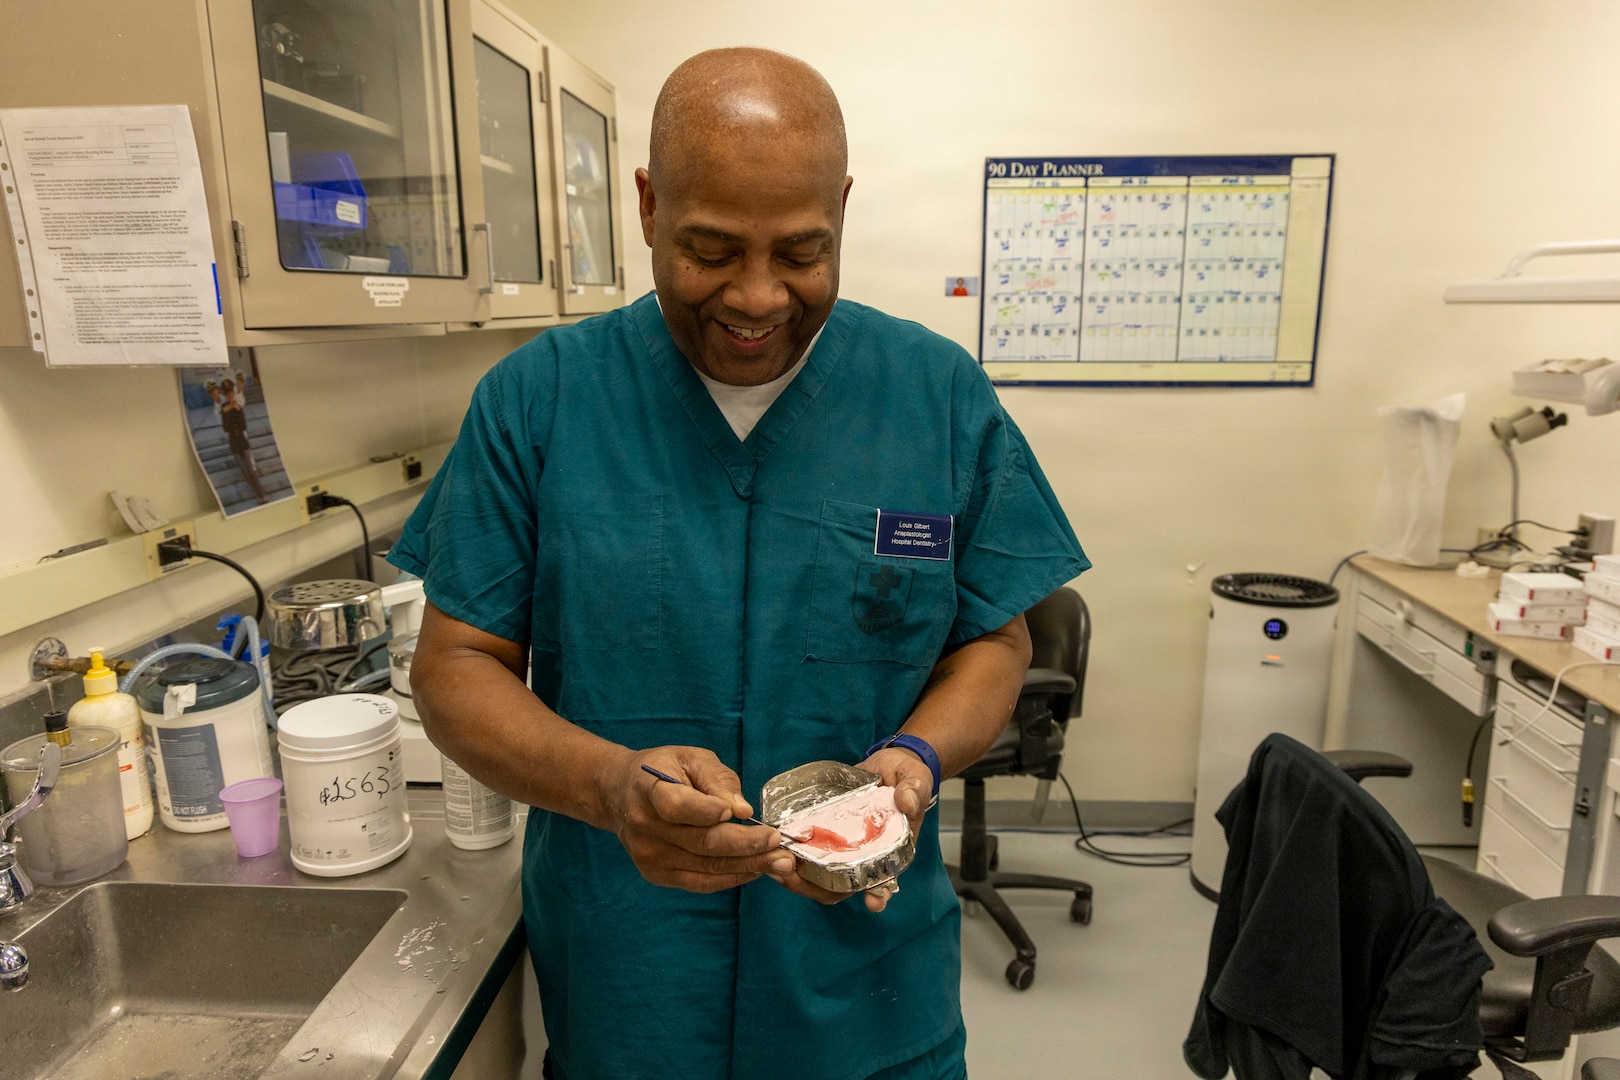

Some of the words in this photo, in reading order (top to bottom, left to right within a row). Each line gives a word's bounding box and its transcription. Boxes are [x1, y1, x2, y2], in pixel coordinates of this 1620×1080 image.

[988, 162, 1007, 177] 90
[1010, 162, 1040, 177] DAY
[1043, 161, 1104, 177] PLANNER
[894, 530, 932, 539] Anaplastologist
[912, 539, 935, 548] Dentistry
[173, 806, 180, 815] DO
[180, 806, 190, 815] NOT
[190, 805, 208, 815] FLUSH
